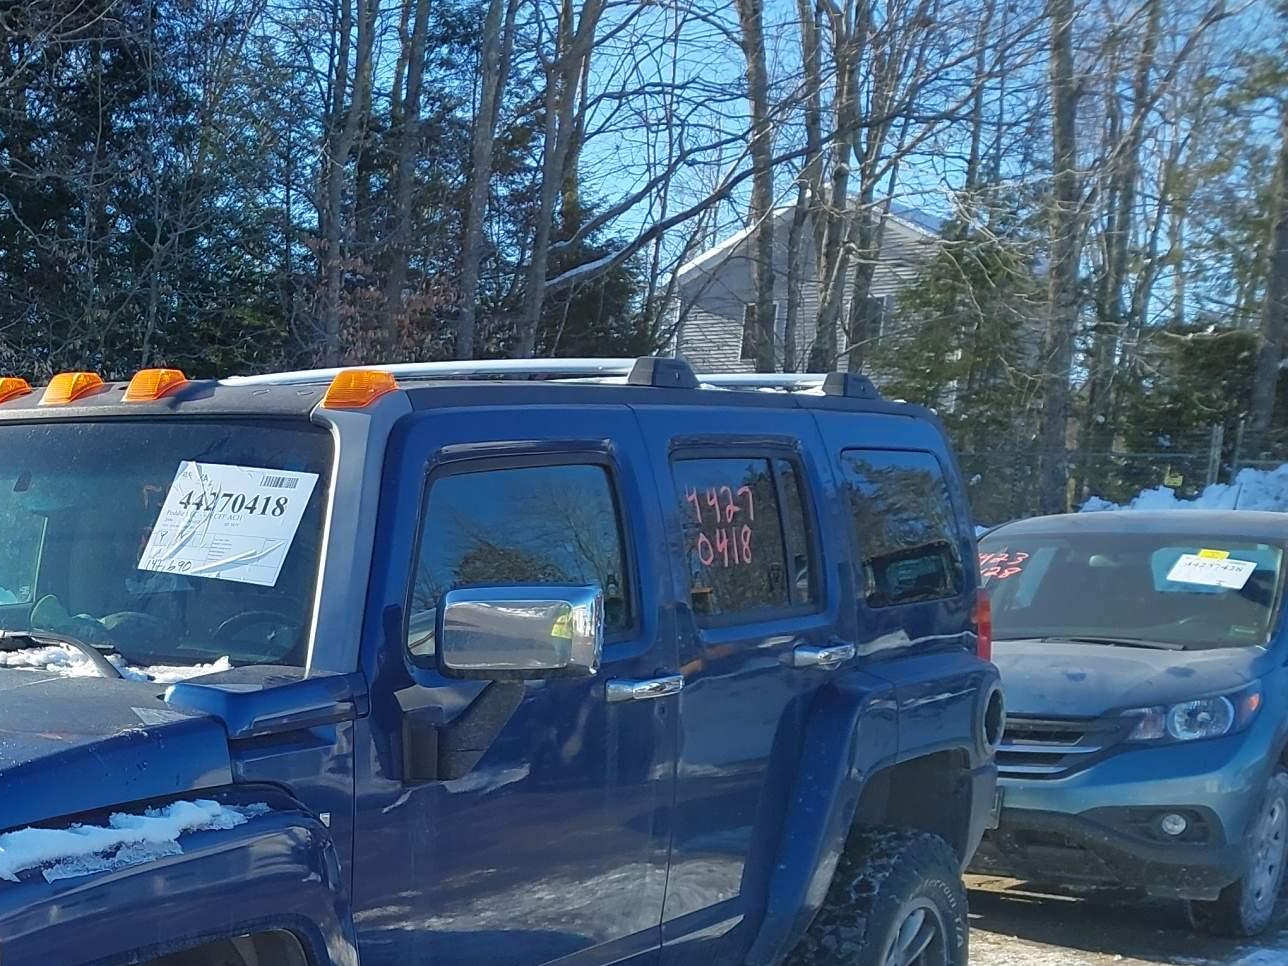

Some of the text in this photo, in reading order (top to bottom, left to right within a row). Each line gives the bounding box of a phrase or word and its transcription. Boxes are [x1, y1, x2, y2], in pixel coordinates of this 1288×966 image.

[178, 489, 289, 518] 44270418
[685, 485, 754, 523] 4427
[697, 524, 753, 567] 0418
